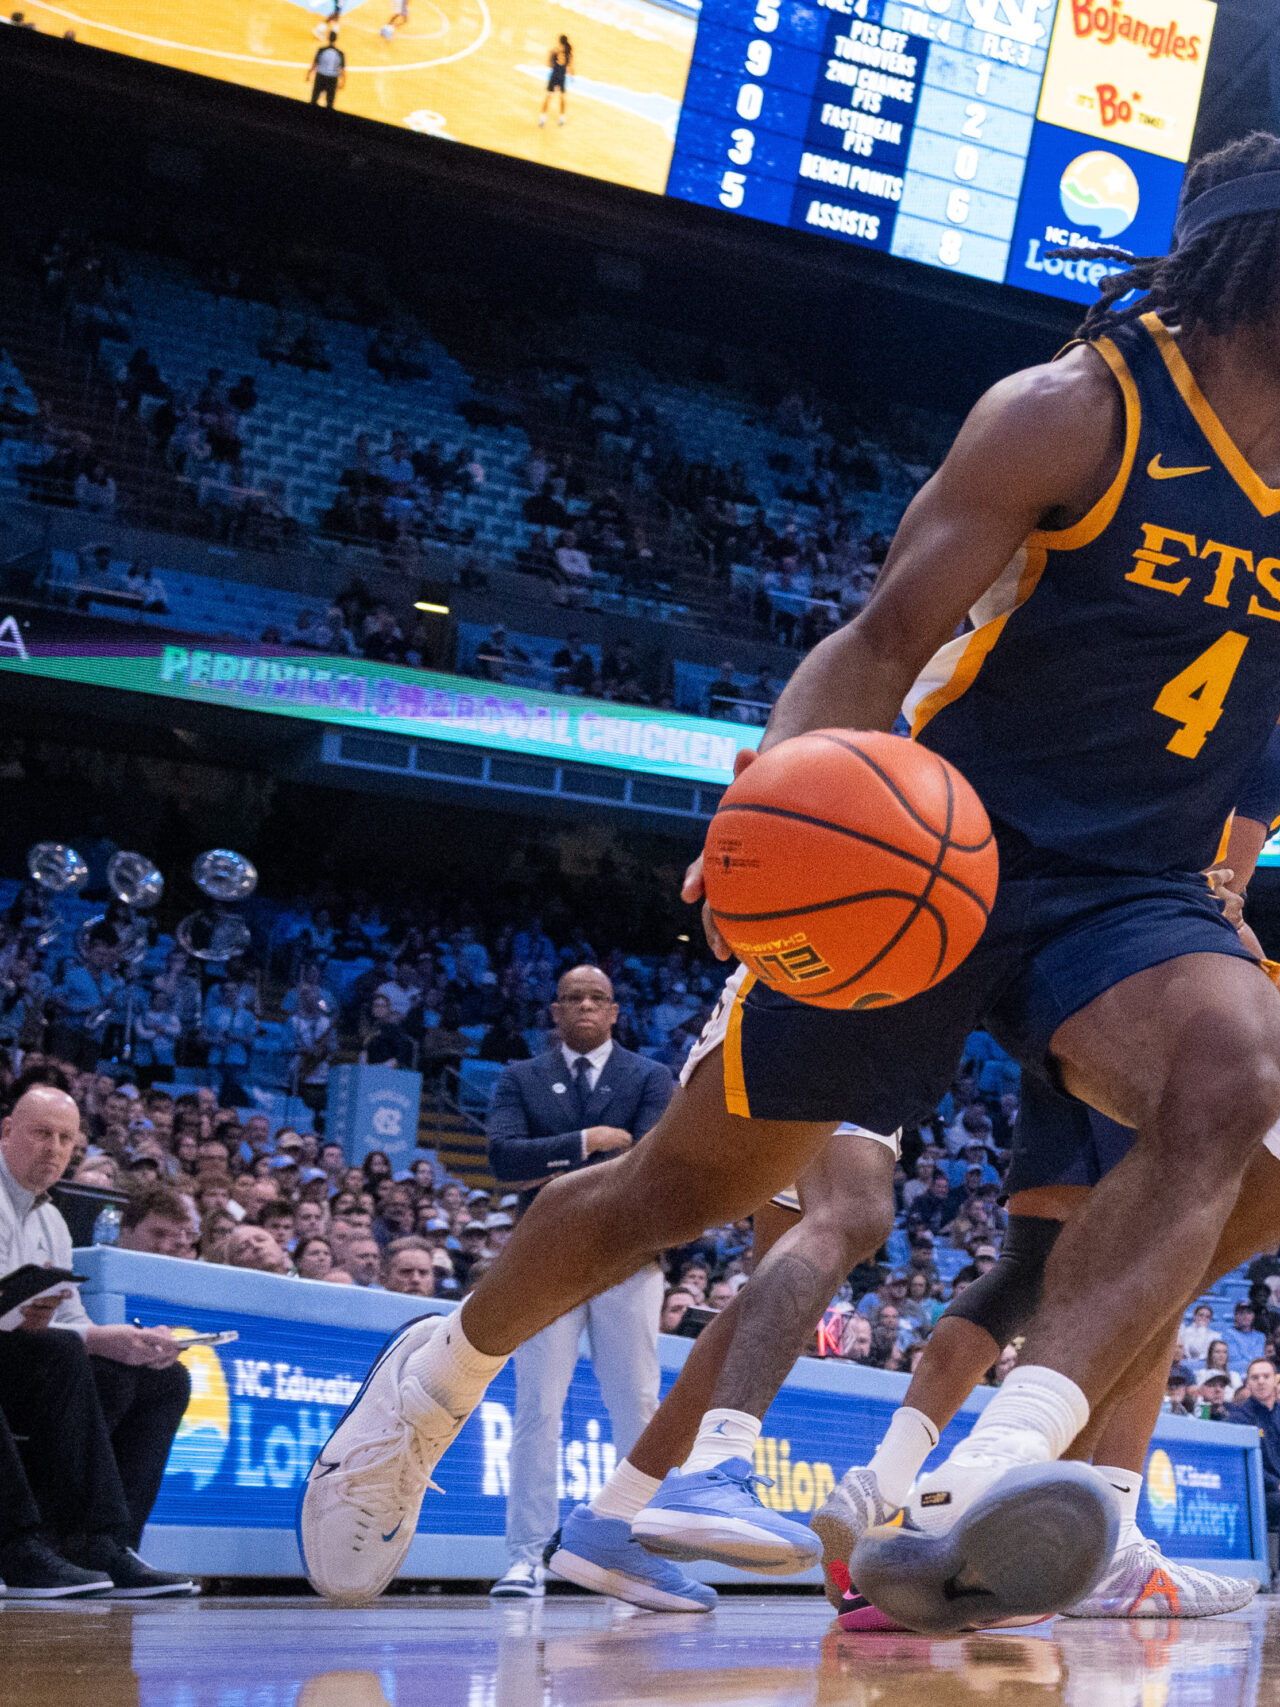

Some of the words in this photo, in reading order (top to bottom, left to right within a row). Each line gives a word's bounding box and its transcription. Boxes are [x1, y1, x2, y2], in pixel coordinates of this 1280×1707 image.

[753, 0, 781, 32] 5
[1071, 0, 1201, 62] Bojangles
[851, 21, 880, 46] PTS
[880, 30, 908, 53] OFF
[744, 40, 773, 77] 9
[827, 61, 858, 86] 2ND
[858, 70, 915, 102] CHANCE
[975, 62, 991, 97] 1
[736, 83, 764, 120] 0
[852, 88, 881, 112] PTS
[1095, 83, 1132, 127] Bo
[821, 104, 902, 144] FASTBREAK
[961, 103, 987, 138] 2
[728, 128, 755, 165] 3
[843, 131, 873, 156] PTS
[799, 152, 850, 188] BENCH
[850, 165, 904, 202] POINTS
[954, 145, 979, 180] 0
[719, 171, 747, 208] 5
[946, 188, 970, 223] 6
[806, 200, 880, 240] ASSISTS
[1044, 226, 1069, 246] NC
[938, 229, 963, 265] 8
[1025, 239, 1135, 302] Lotte
[1152, 629, 1250, 760] 4
[577, 711, 737, 771] CHICKEN
[234, 1359, 272, 1398] NC
[234, 1402, 334, 1488] Lott
[754, 1436, 836, 1513] llion
